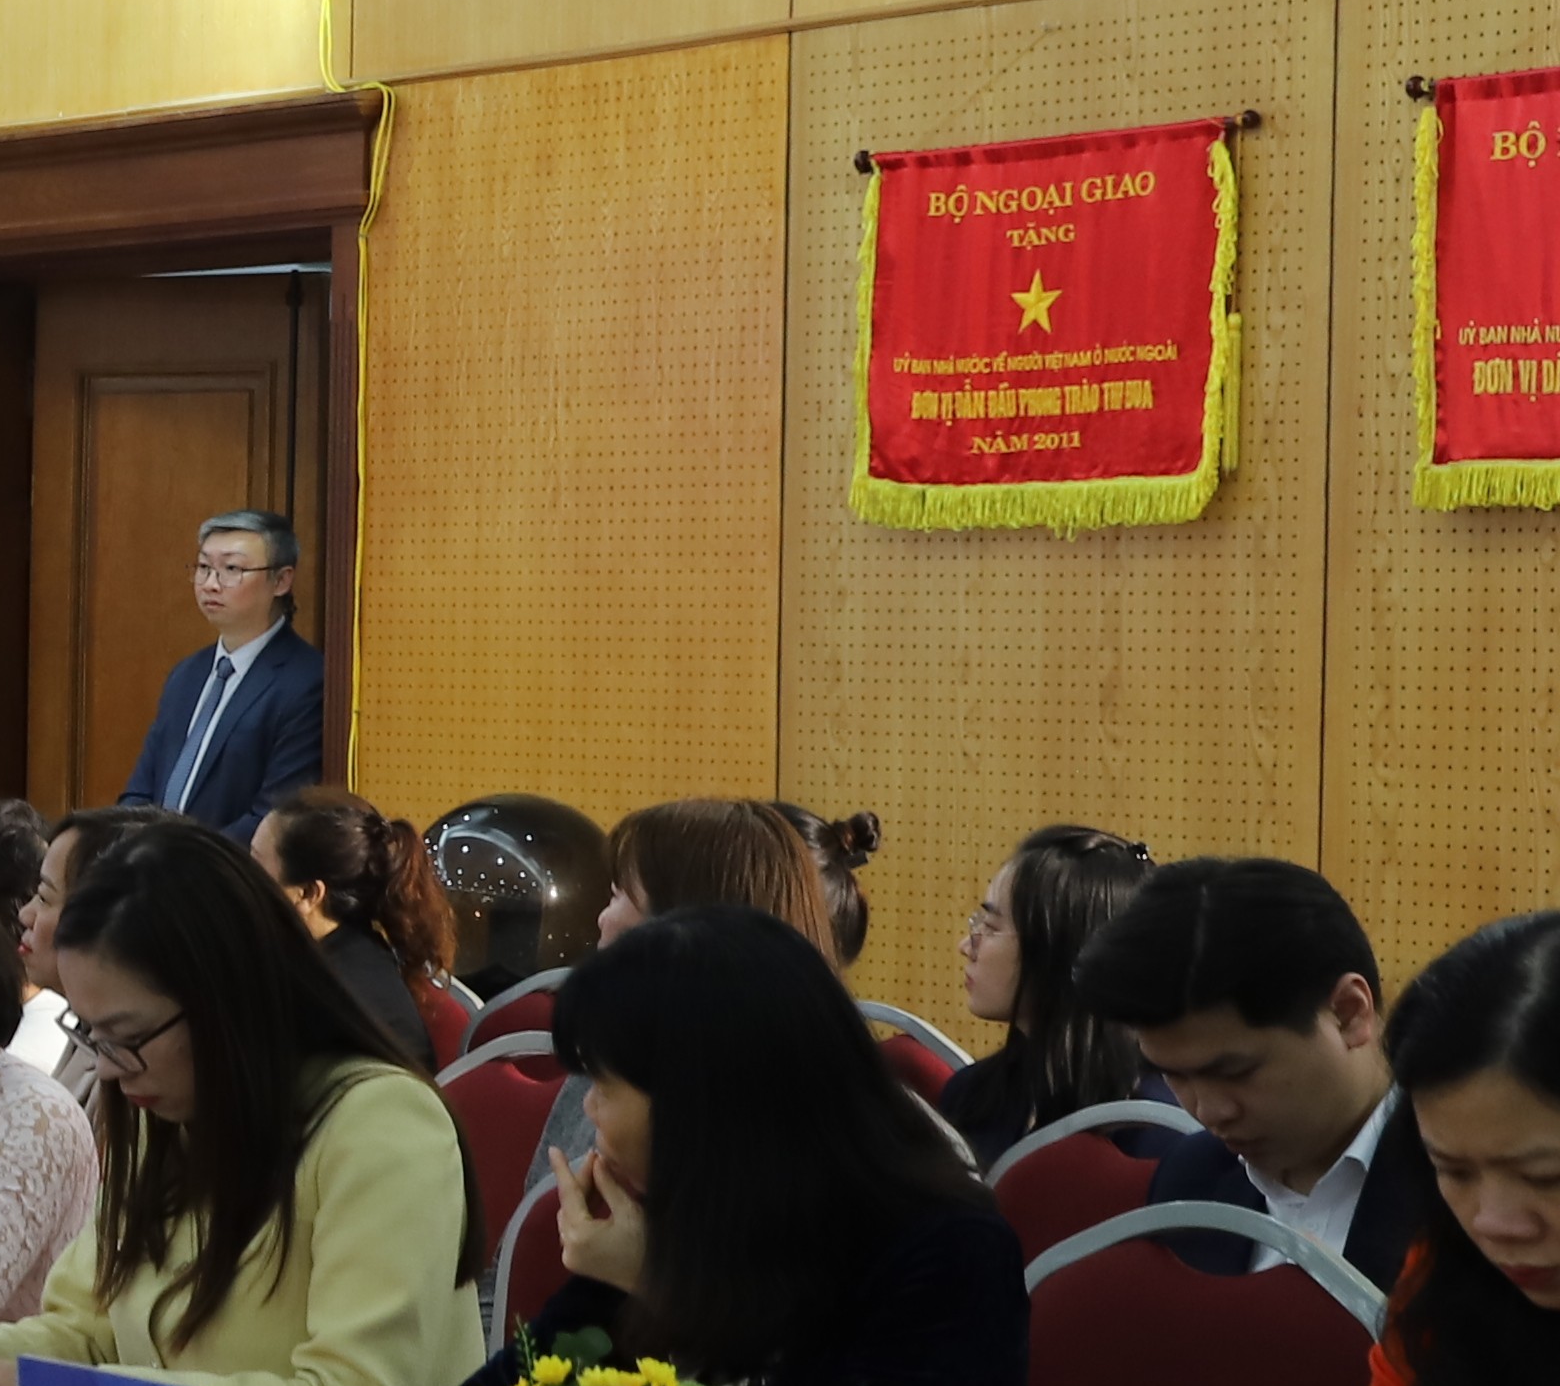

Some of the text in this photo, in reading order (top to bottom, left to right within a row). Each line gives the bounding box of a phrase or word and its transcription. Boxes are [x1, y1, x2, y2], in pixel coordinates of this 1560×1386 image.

[1490, 119, 1548, 169] BỘ
[927, 170, 1157, 224] BỘ NGOẠI GIAO
[1479, 325, 1508, 346] BAN
[1064, 351, 1092, 370] NAM
[1473, 356, 1514, 396] ĐƠN
[1517, 358, 1538, 403] VỊ
[1032, 430, 1082, 452] 2011
